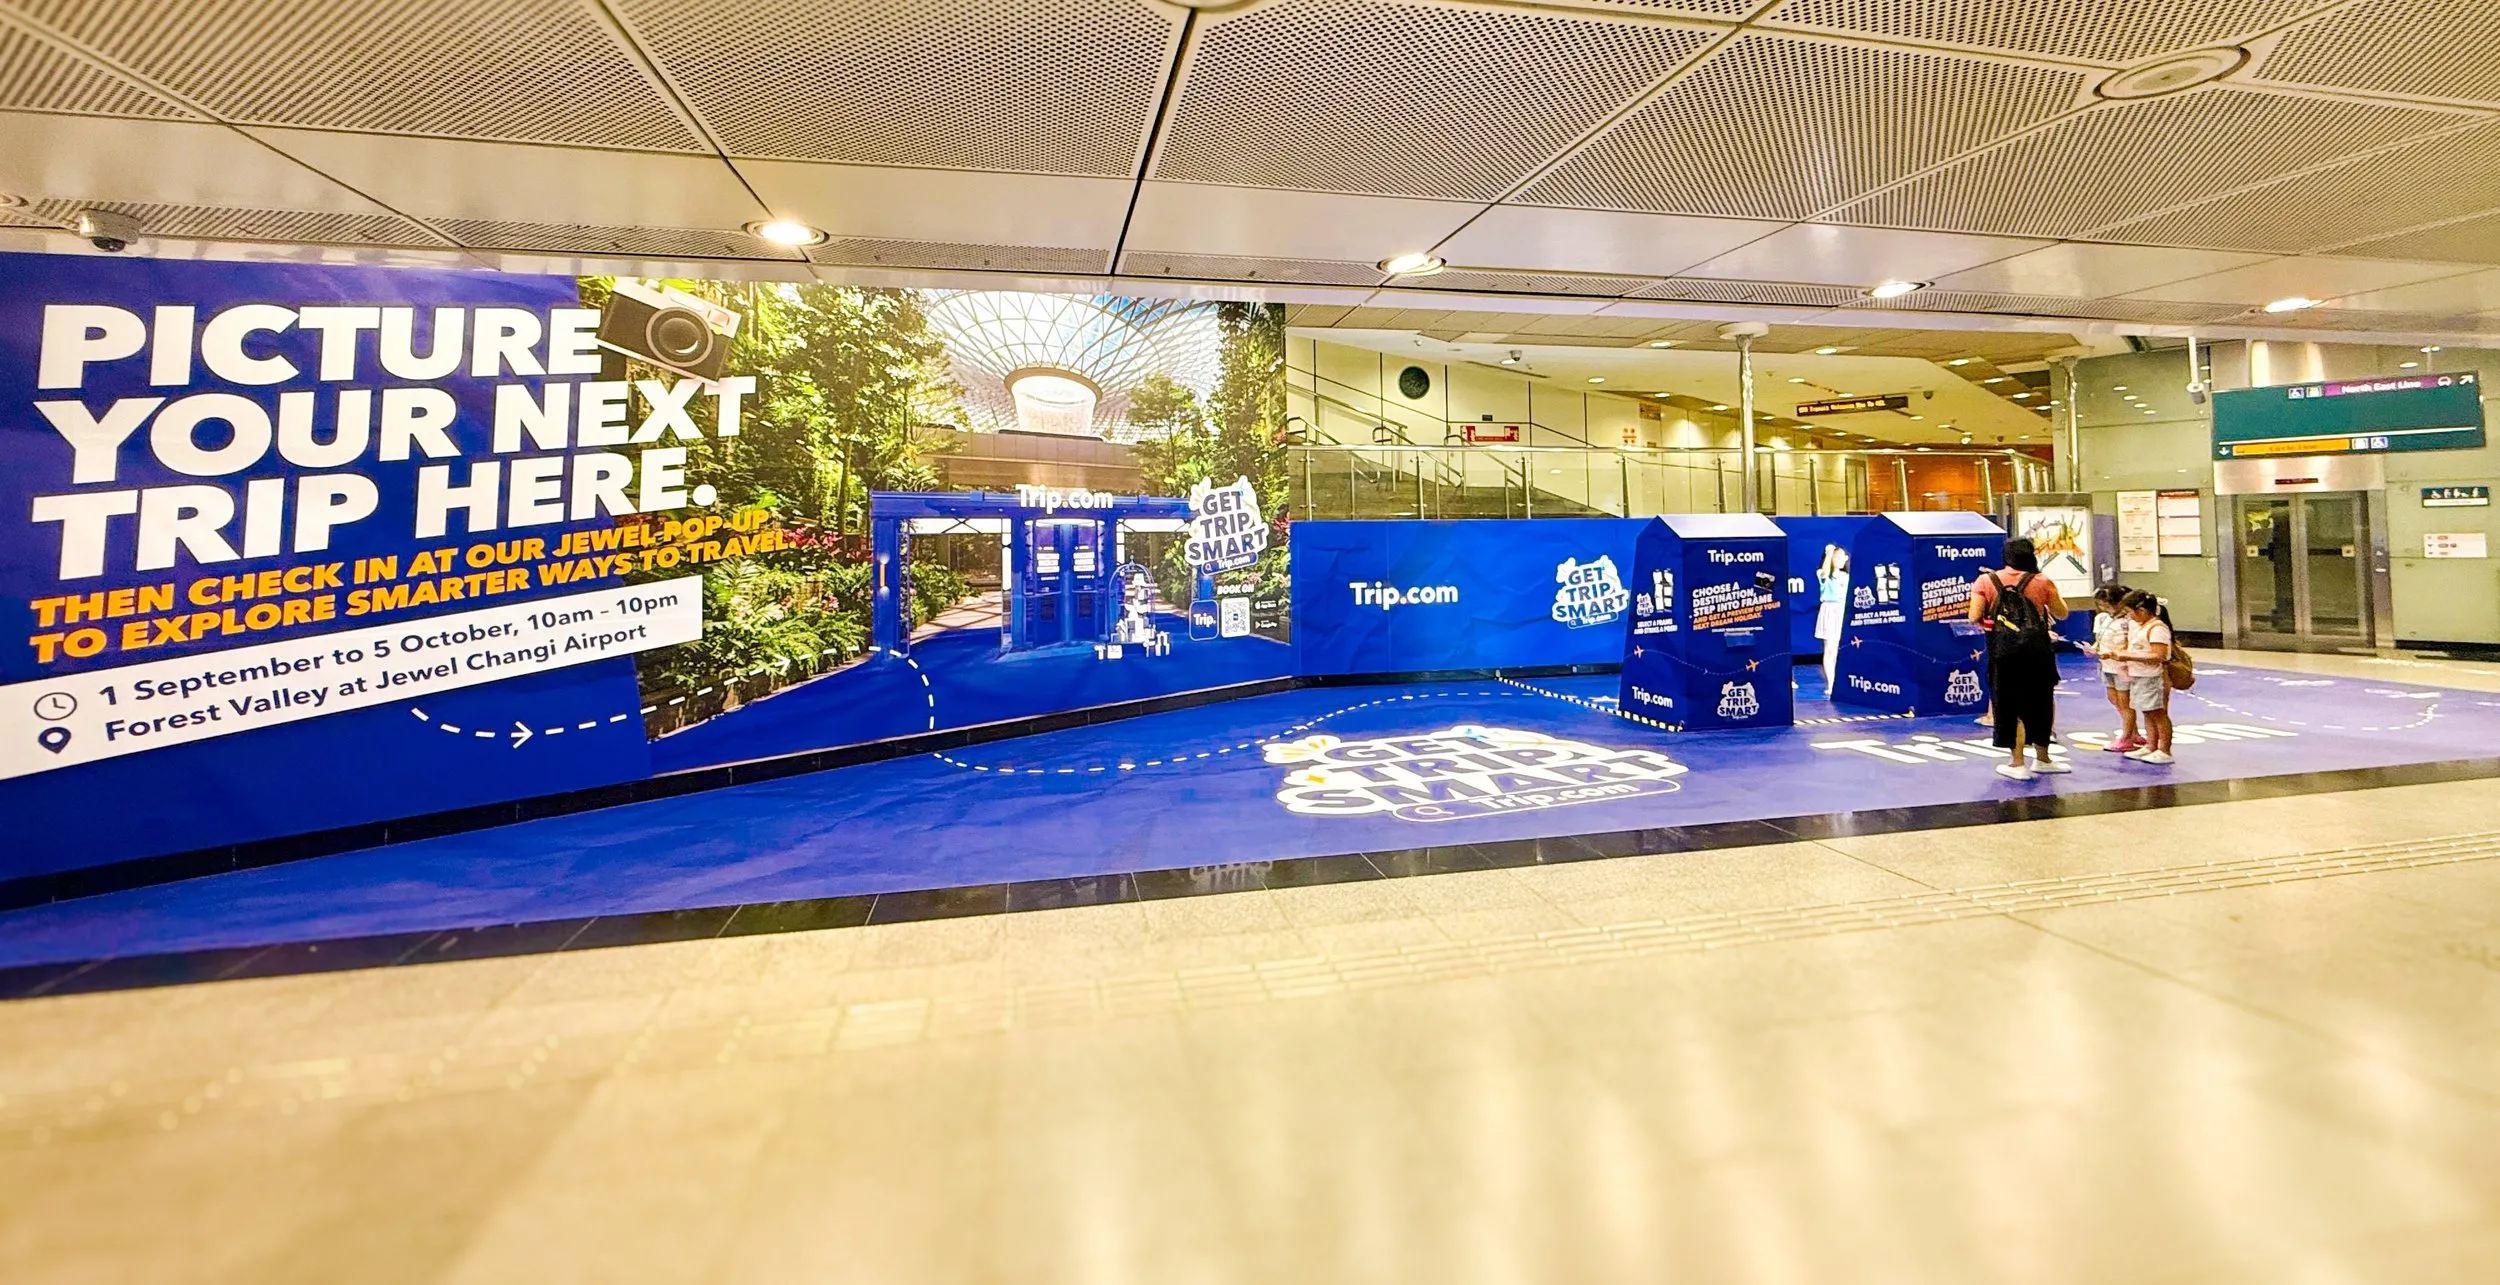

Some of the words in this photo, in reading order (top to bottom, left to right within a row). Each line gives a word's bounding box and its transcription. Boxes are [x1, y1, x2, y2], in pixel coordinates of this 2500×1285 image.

[38, 304, 600, 389] PICTURE
[2341, 383, 2372, 394] North
[2373, 382, 2396, 392] East
[2398, 380, 2422, 389] Line
[33, 386, 461, 484] YOUR
[493, 376, 756, 454] NEXT
[1015, 484, 1114, 514] Trip.com
[1203, 491, 1244, 515] GET
[32, 473, 379, 580] TRIP
[415, 447, 717, 539] HERE.
[1200, 512, 1250, 538] TRIP
[1189, 528, 1265, 561] SMART
[1935, 545, 1986, 561] Trip.com
[30, 584, 175, 627] THEN
[188, 562, 344, 606] CHECK
[353, 555, 398, 585] IN
[406, 549, 457, 578] AT
[465, 538, 546, 569] OUR
[553, 525, 653, 556] JEWEL
[663, 510, 770, 542] POP-UP
[1217, 555, 1250, 570] Trip.com
[1707, 549, 1764, 566] Trip.com
[1568, 567, 1604, 585] GET
[1922, 576, 1957, 591] CHOOSE
[1958, 575, 1965, 584] A
[29, 628, 107, 663] TO
[121, 594, 336, 650] EXPLORE
[345, 567, 530, 616] SMARTER
[537, 554, 633, 587] WAYS
[640, 546, 681, 571] TO
[687, 530, 798, 562] TRAVEL.
[1217, 585, 1241, 595] BOOK
[1241, 584, 1255, 594] ON
[1349, 582, 1459, 610] Trip.com
[1692, 583, 1731, 598] CHOOSE
[1732, 582, 1740, 591] A
[1693, 588, 1757, 607] DESTINATION,
[1556, 594, 1625, 618] SMART
[1693, 605, 1716, 617] STEP
[1717, 601, 1740, 612] INTO
[1741, 594, 1773, 607] FRAME
[1923, 597, 1943, 609] STEP
[1944, 593, 1965, 604] INTO
[1923, 607, 1936, 615] AND
[1193, 614, 1216, 627] Trip.
[1693, 616, 1708, 624] AND
[1709, 613, 1721, 621] GET
[1727, 607, 1754, 618] PREVIEW
[1763, 601, 1781, 610] YOUR
[1923, 614, 1937, 622] NEXT
[1693, 622, 1710, 631] NEXT
[1710, 618, 1733, 627] DREAM
[99, 686, 117, 706] 1
[134, 656, 324, 701] September
[333, 648, 364, 666] to
[374, 639, 391, 658] 5
[400, 619, 520, 653] October,
[526, 608, 594, 631] 10am
[616, 592, 679, 618] 10pm
[105, 704, 221, 741] Forest
[228, 686, 329, 718] Valley
[339, 678, 367, 696] at
[376, 657, 459, 691] Jewel
[466, 638, 557, 671] Changi
[563, 624, 647, 658] Airport
[1848, 674, 1901, 695] Trip.com
[1955, 676, 1972, 684] GET
[1631, 685, 1673, 709] Trip.com
[1728, 688, 1748, 697] GET
[1947, 692, 1980, 703] SMART
[1719, 705, 1757, 715] SMART
[1324, 735, 1500, 761] GET
[1295, 754, 1670, 809] SMART
[1468, 782, 1642, 810] Trip.com
